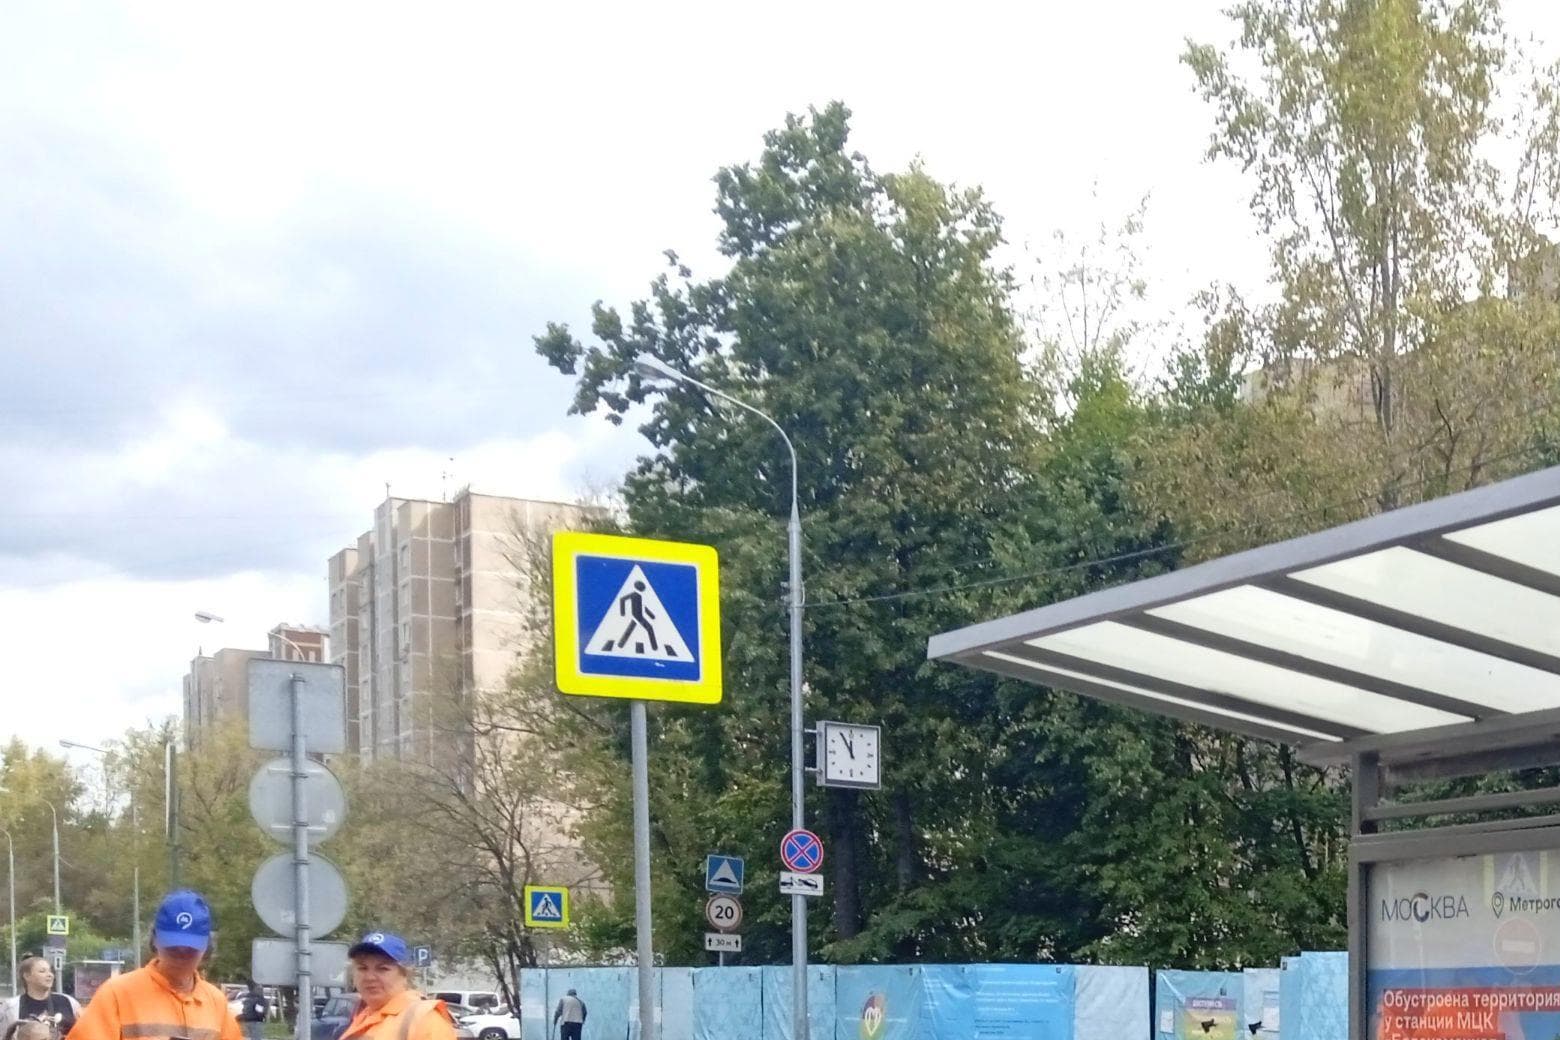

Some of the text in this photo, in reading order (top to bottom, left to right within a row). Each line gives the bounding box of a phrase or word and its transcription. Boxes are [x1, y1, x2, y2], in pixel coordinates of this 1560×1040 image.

[715, 905, 734, 920] 20
[1381, 892, 1470, 923] МОСКВА
[716, 938, 726, 946] 30
[1384, 990, 1470, 1012] Обустроена
[1384, 1012, 1494, 1032] у станции МЦК
